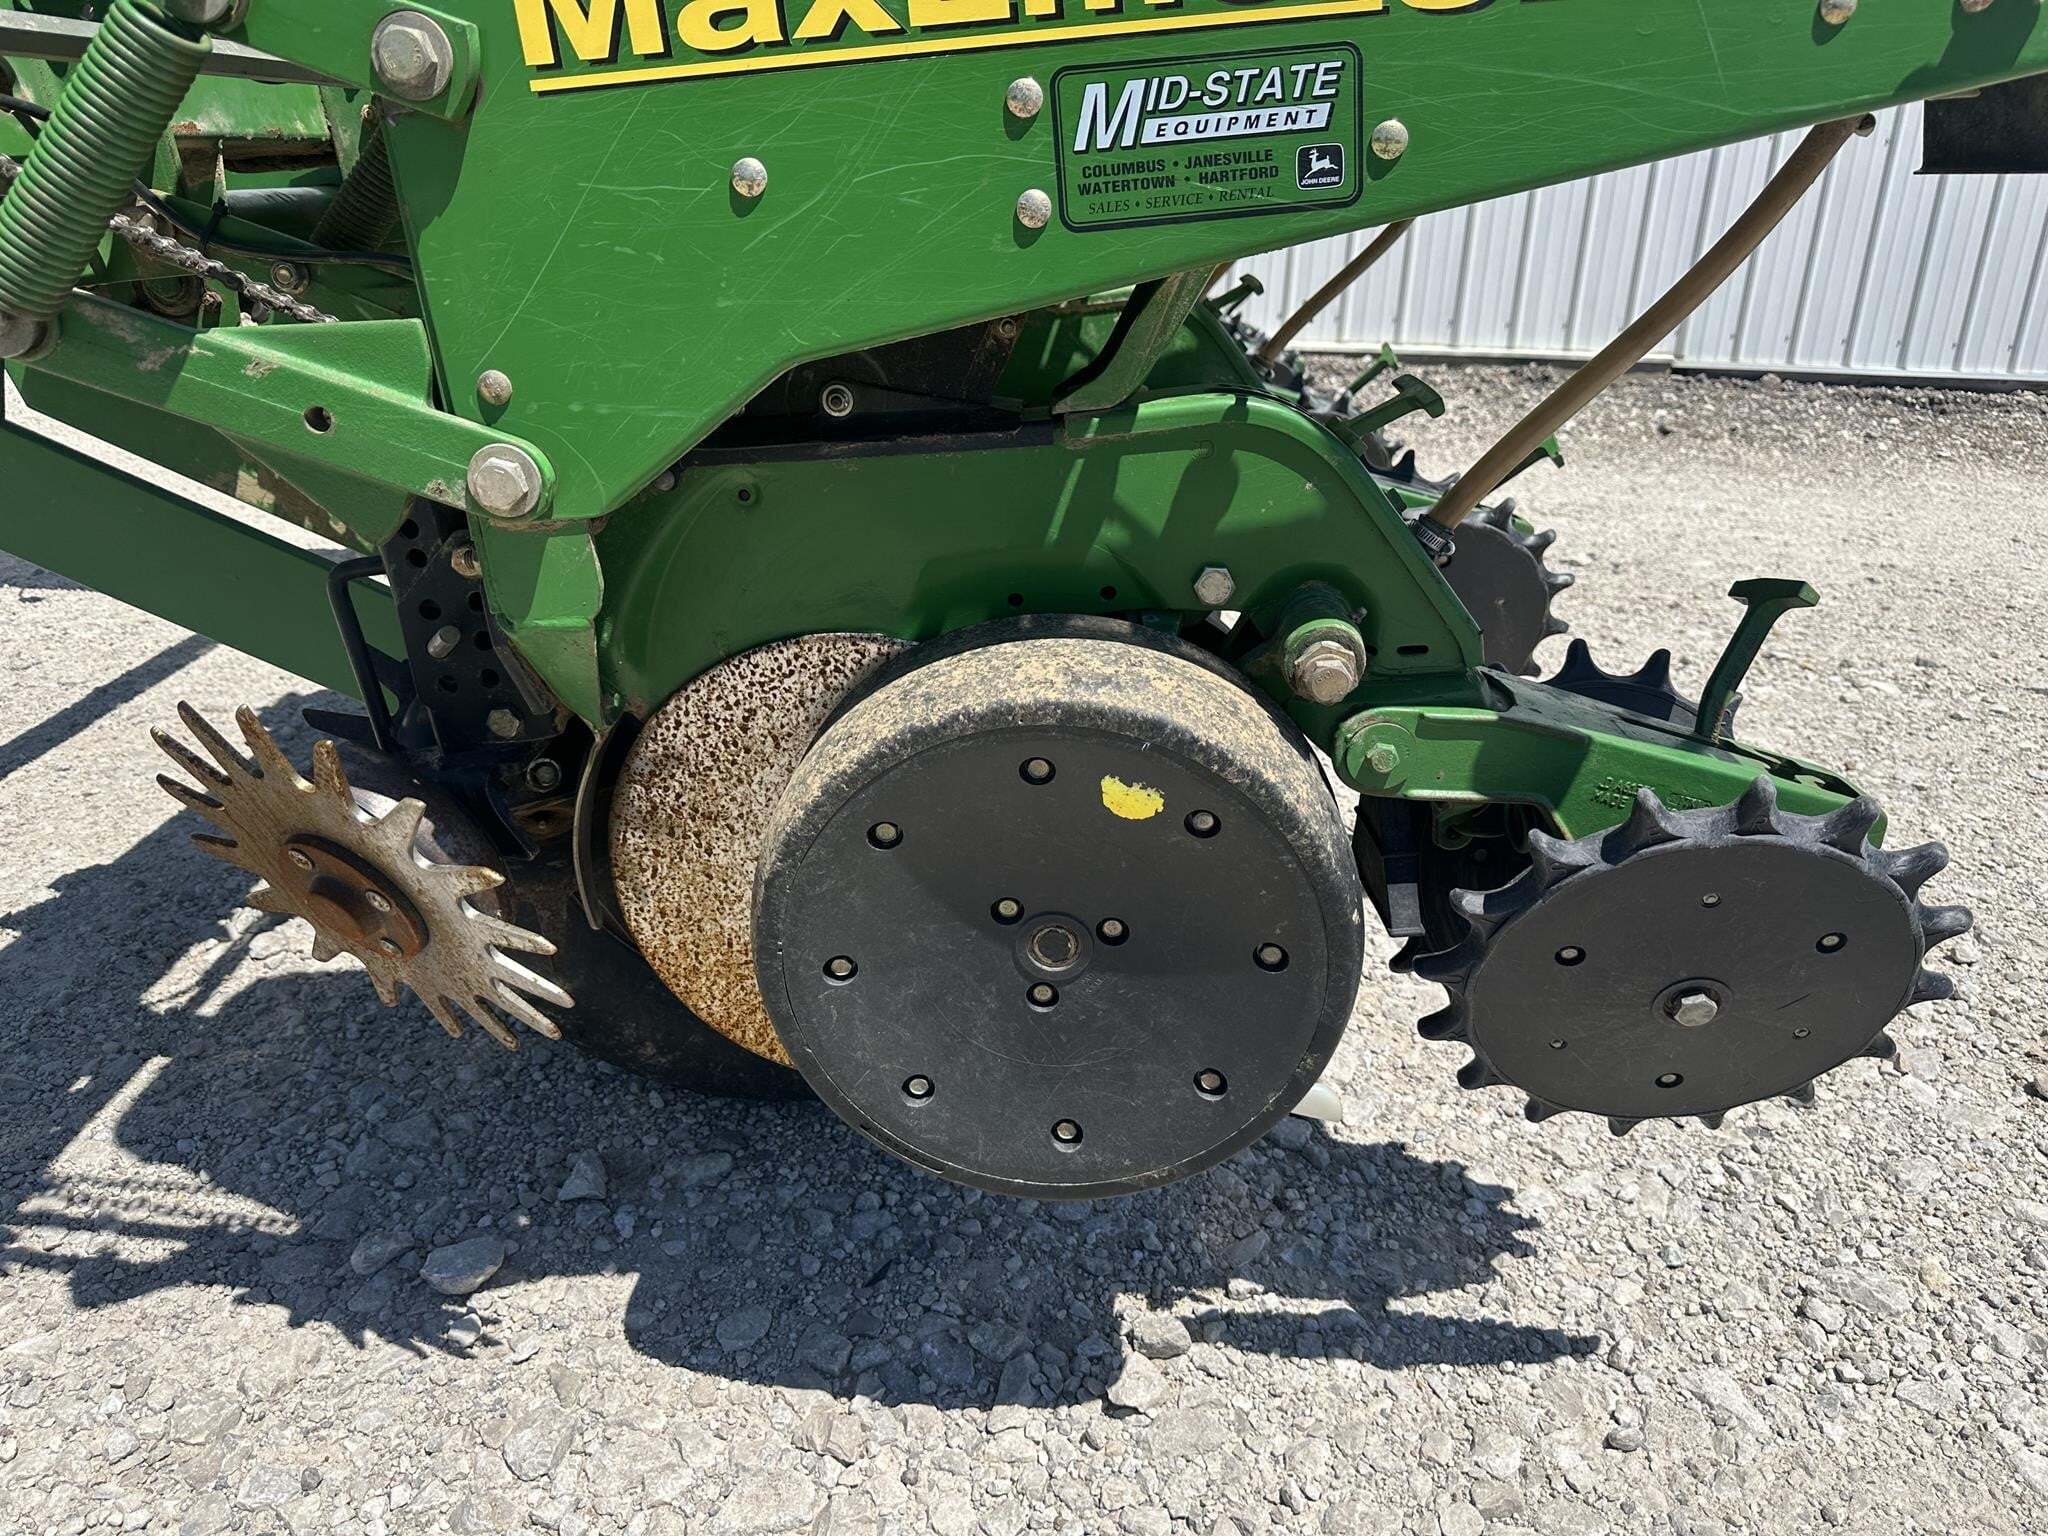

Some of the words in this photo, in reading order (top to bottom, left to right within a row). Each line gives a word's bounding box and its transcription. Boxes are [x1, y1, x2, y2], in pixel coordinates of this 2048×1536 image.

[1073, 61, 1343, 151] MID-STATE
[1156, 109, 1318, 138] EQUIPMENT
[1082, 159, 1166, 179] COLUMBUS
[1184, 149, 1273, 169] JANESVILLE
[1078, 174, 1176, 196] WATERTOWN
[1200, 165, 1279, 184] HARTFORD
[1300, 178, 1318, 186] JOHN
[1318, 175, 1340, 184] DEERE
[1088, 199, 1131, 216] SALES
[1145, 192, 1202, 210] SERVICE
[1218, 186, 1275, 203] RENTAL
